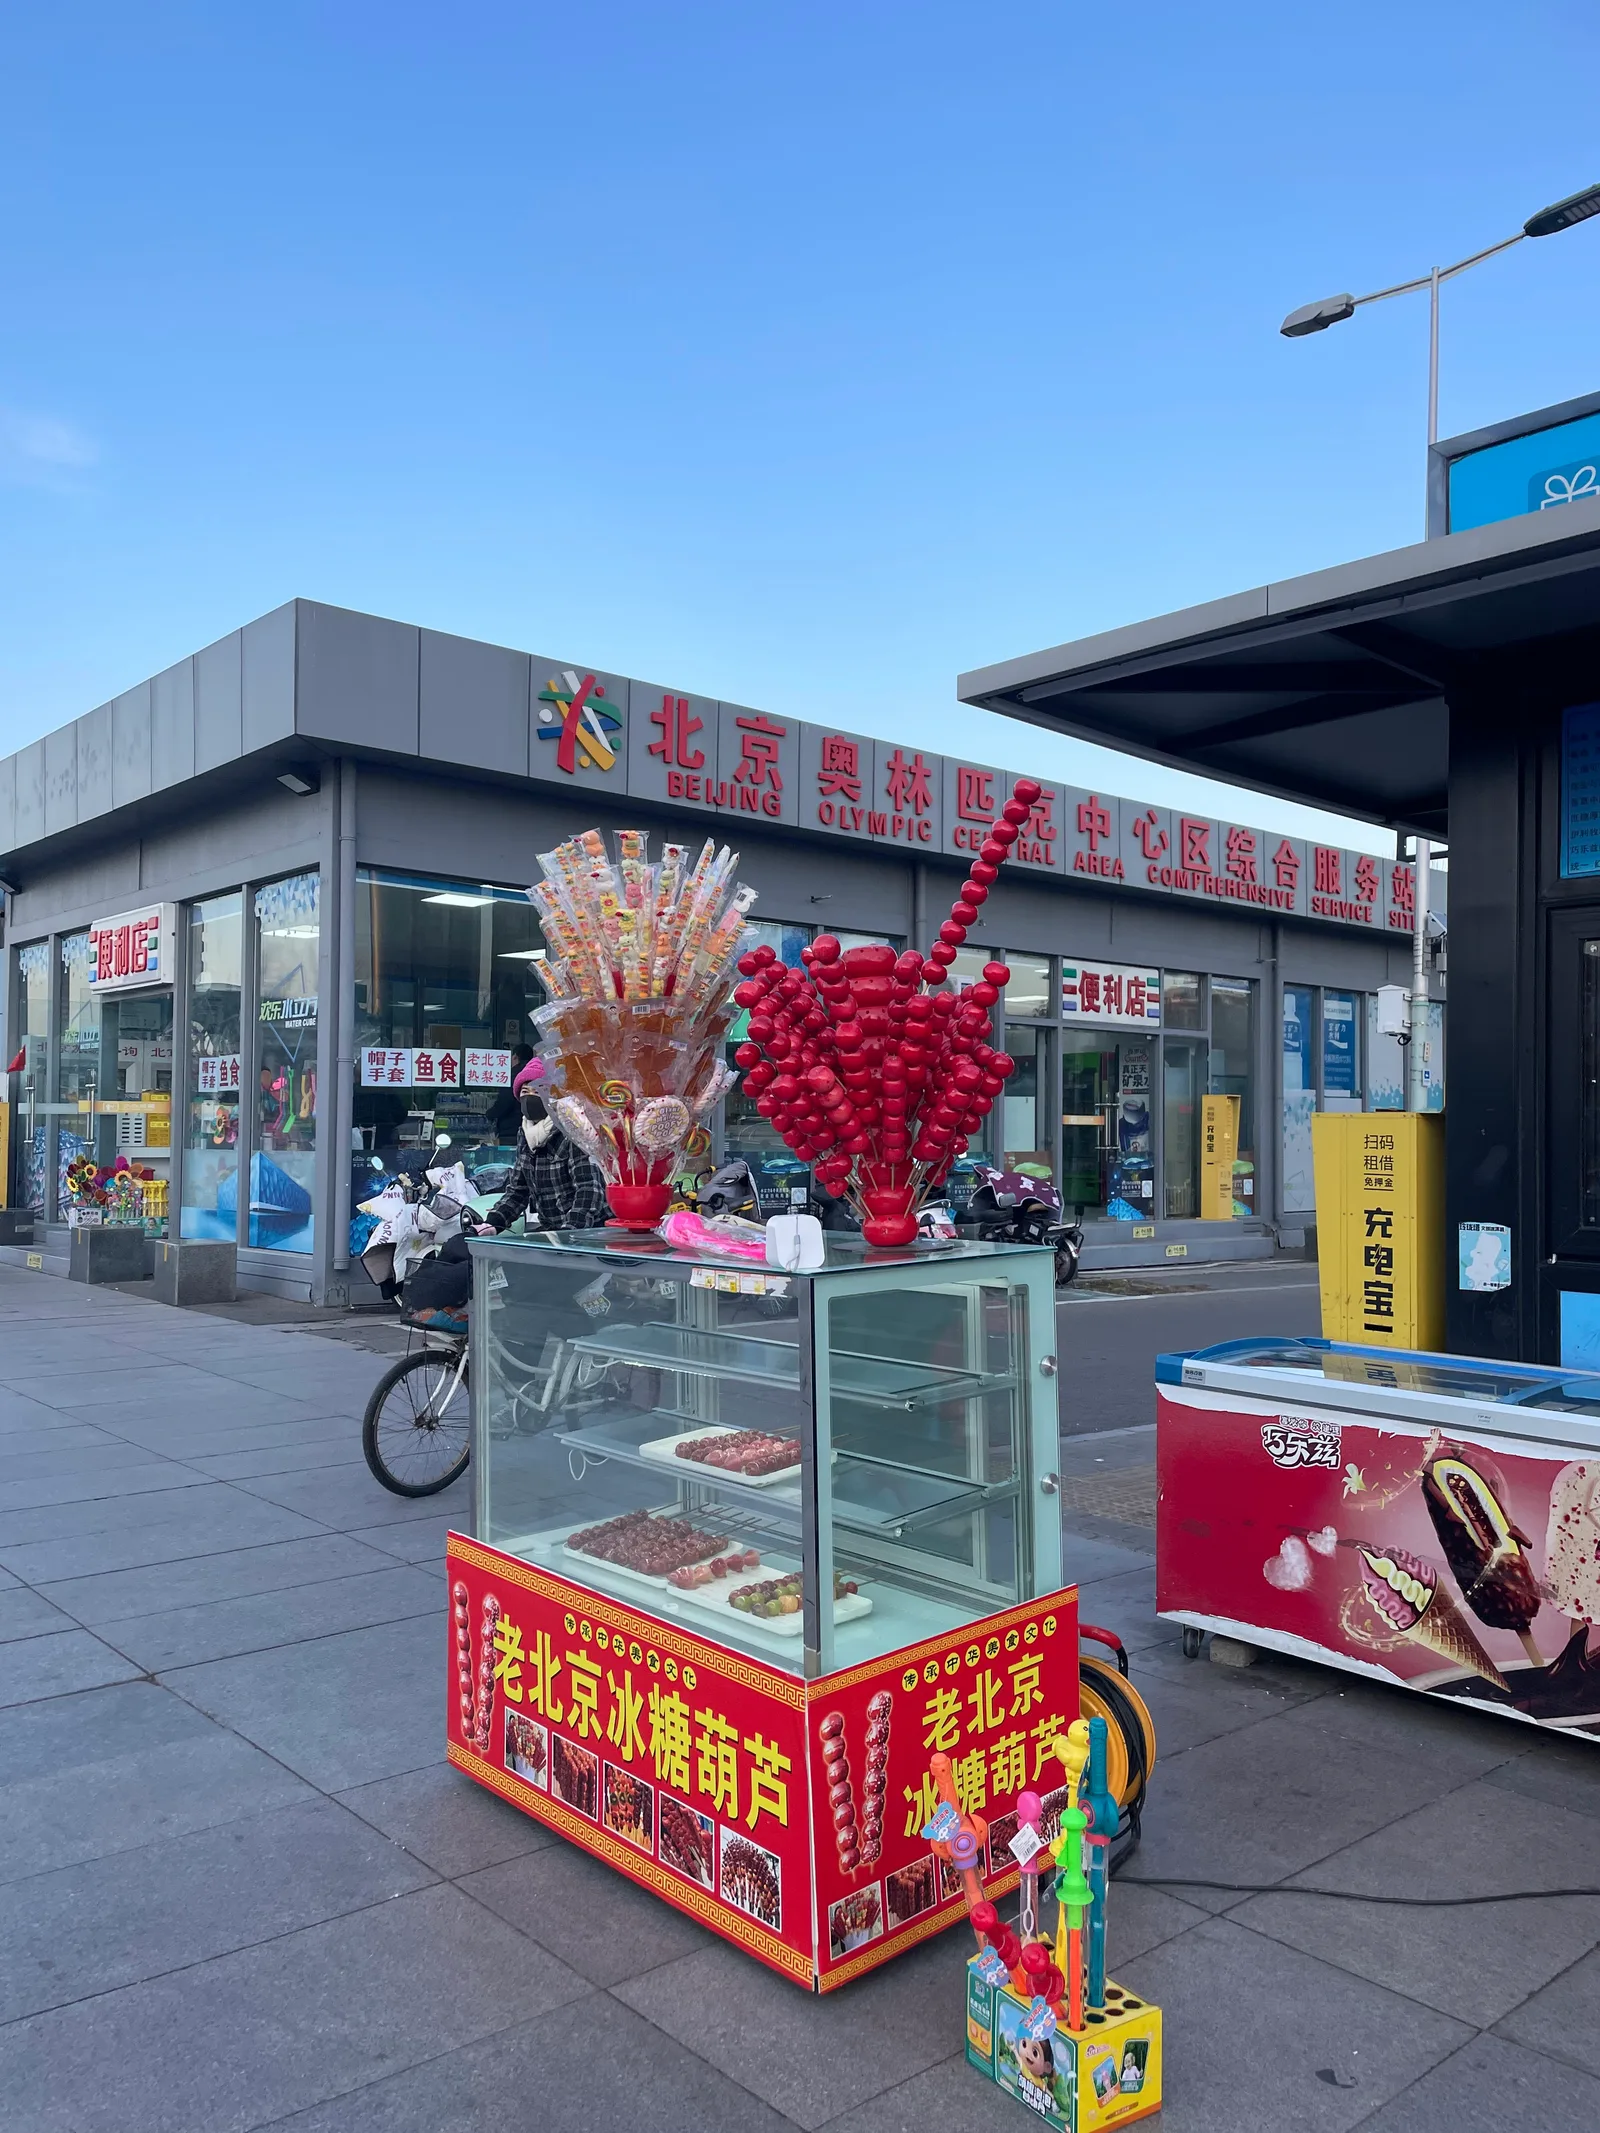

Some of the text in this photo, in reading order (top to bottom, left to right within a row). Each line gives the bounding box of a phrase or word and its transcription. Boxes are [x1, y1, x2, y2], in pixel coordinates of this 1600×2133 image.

[648, 694, 1415, 912] 北京奥林匹克中心区综合服务站
[668, 771, 781, 816] BEIJING
[819, 800, 932, 841] OLYMPIC
[954, 825, 1056, 866] CERAL
[1074, 851, 1125, 879] AREA
[1147, 864, 1295, 910] COMPREHENSIVE
[1311, 895, 1372, 922] SERVICE
[97, 920, 149, 980] 便利店
[1078, 970, 1146, 1018] 便利店
[202, 1060, 216, 1074] 帽子
[219, 1058, 240, 1087] 鱼食
[367, 1051, 406, 1066] 帽子
[414, 1052, 458, 1084] 鱼食
[467, 1052, 509, 1067] 老北京
[202, 1075, 216, 1088] 手套
[367, 1067, 405, 1083] 手套
[467, 1069, 509, 1084] 热梨汤
[1363, 1134, 1394, 1151] 扫码
[1363, 1155, 1394, 1172] 租借
[1363, 1177, 1394, 1188] 免押金
[1363, 1207, 1394, 1318] 充电宝
[1262, 1424, 1340, 1468] 巧乐兹
[565, 1614, 697, 1689] 传承中华美食文化
[903, 1617, 1056, 1690] 传承中华美食文化
[922, 1652, 1045, 1752] 老北京
[493, 1613, 792, 1829] 老北京冰糖葫芦
